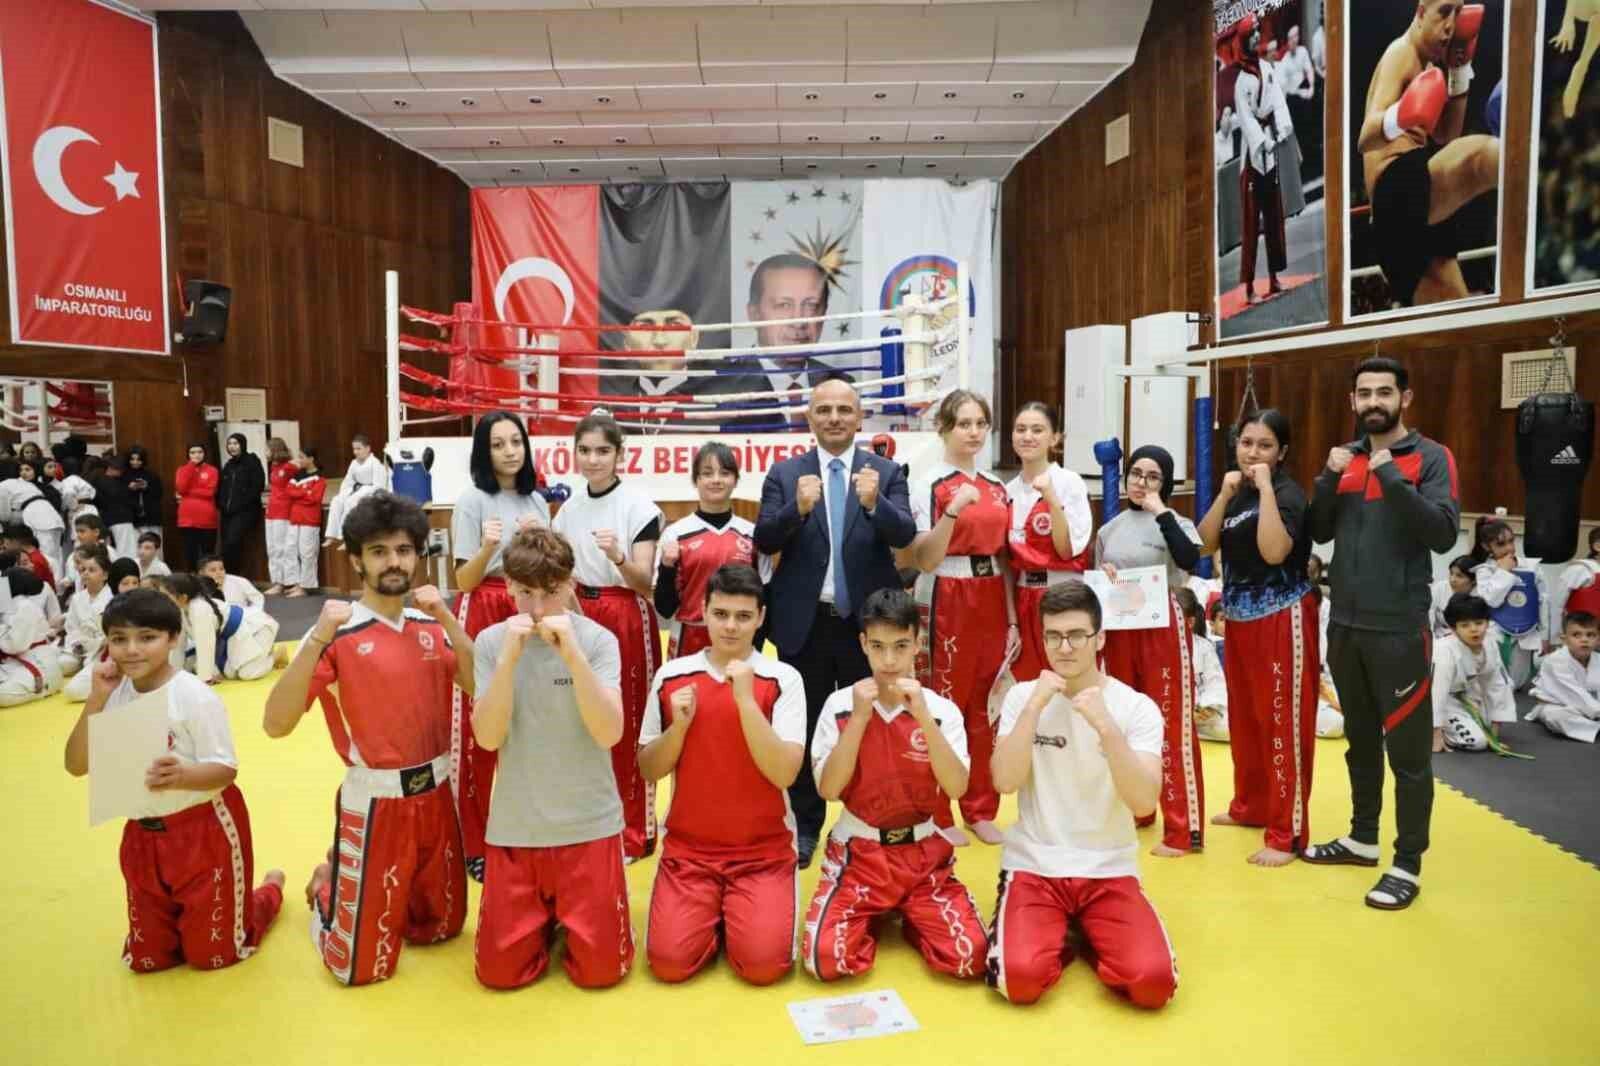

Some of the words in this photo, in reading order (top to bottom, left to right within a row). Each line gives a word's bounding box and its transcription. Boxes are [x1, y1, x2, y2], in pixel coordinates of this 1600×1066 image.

[35, 294, 152, 322] İMPARATORLUĞU
[64, 283, 127, 302] OSMANLI
[1273, 737, 1288, 799] BOKS
[210, 867, 224, 943] KICK
